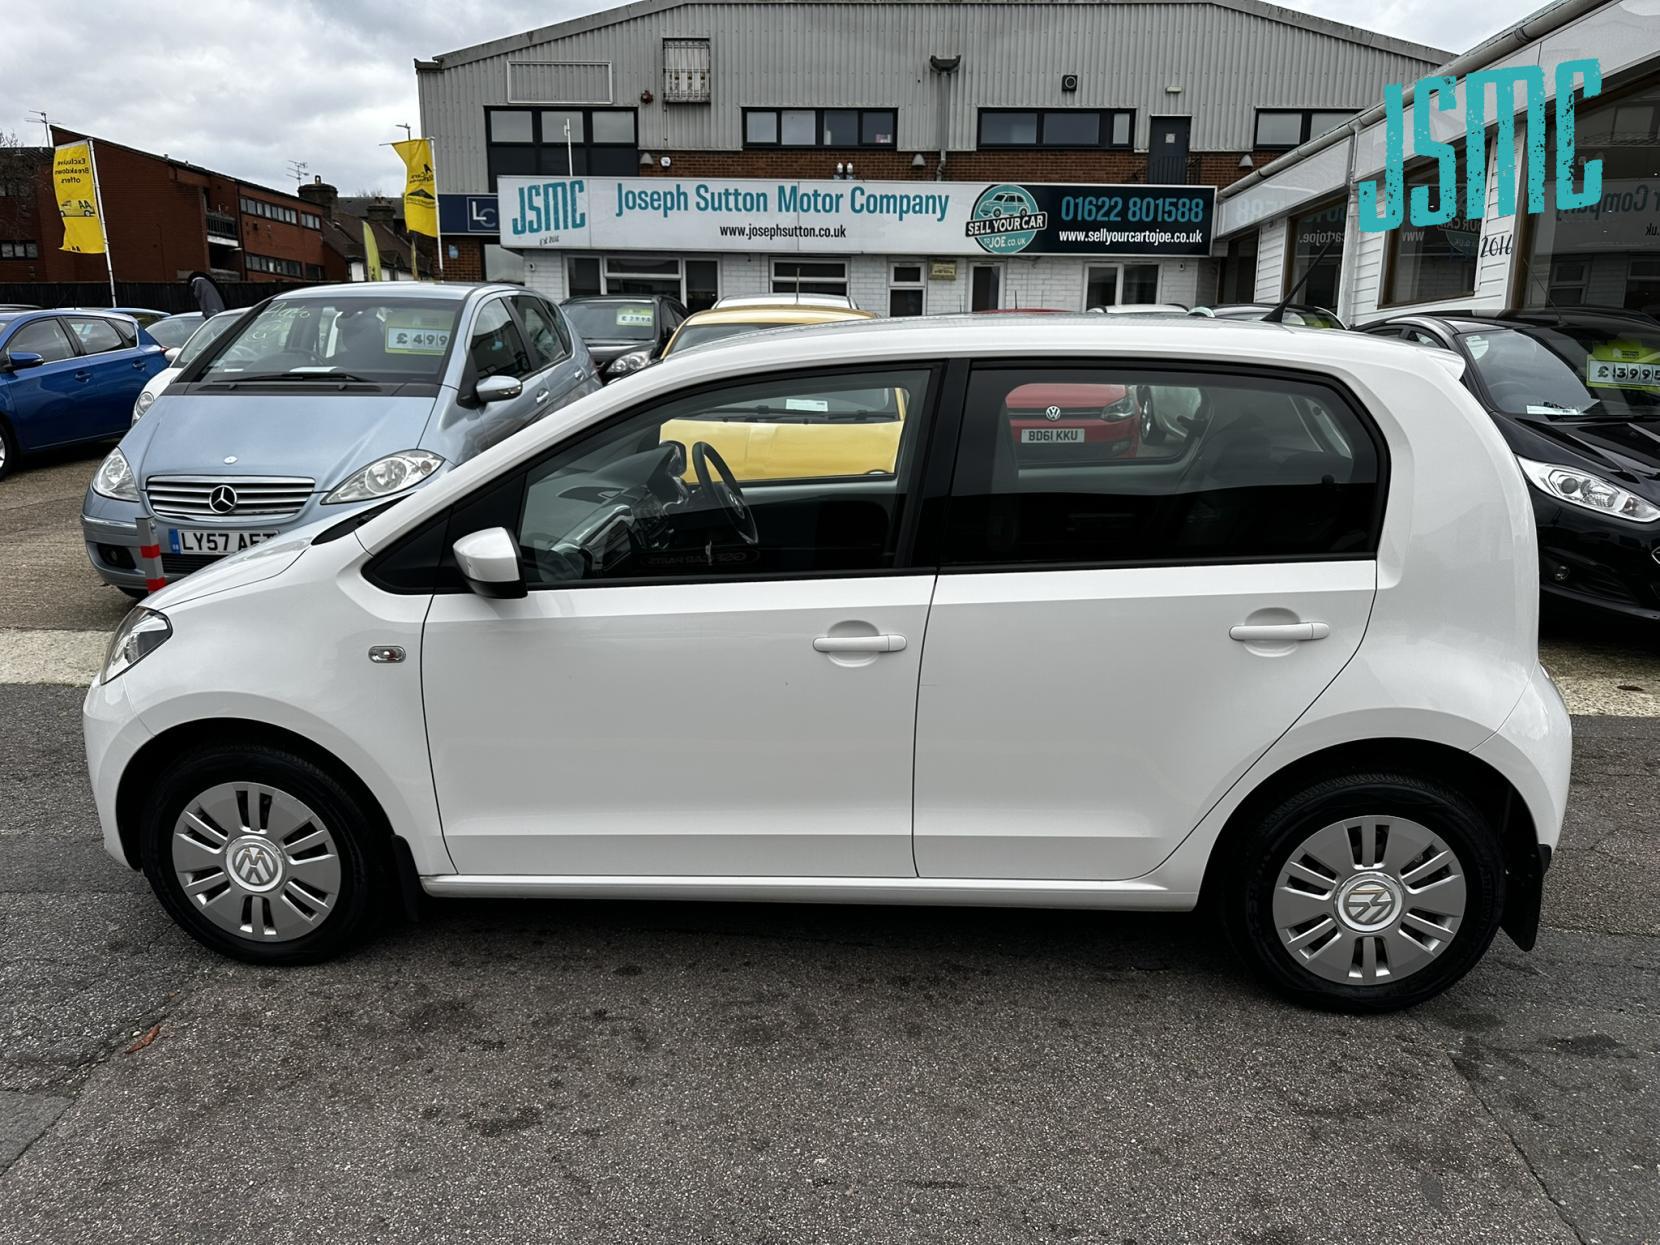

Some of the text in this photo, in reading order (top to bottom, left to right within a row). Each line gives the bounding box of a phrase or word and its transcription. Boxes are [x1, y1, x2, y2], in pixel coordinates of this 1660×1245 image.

[512, 180, 586, 235] JSMC
[616, 183, 949, 222] Joseph Sutton Motor Company
[1061, 196, 1121, 222] 01622
[1127, 197, 1204, 223] 801588
[719, 223, 847, 241] www.josephsutton.co.uk
[967, 215, 1044, 236] SELL YOUR CAR
[989, 236, 1006, 248] JOE
[1058, 228, 1203, 246] www.sellyourcartojoe.co.uk
[1028, 430, 1078, 441] BD61 KKU
[181, 532, 230, 551] LY57
